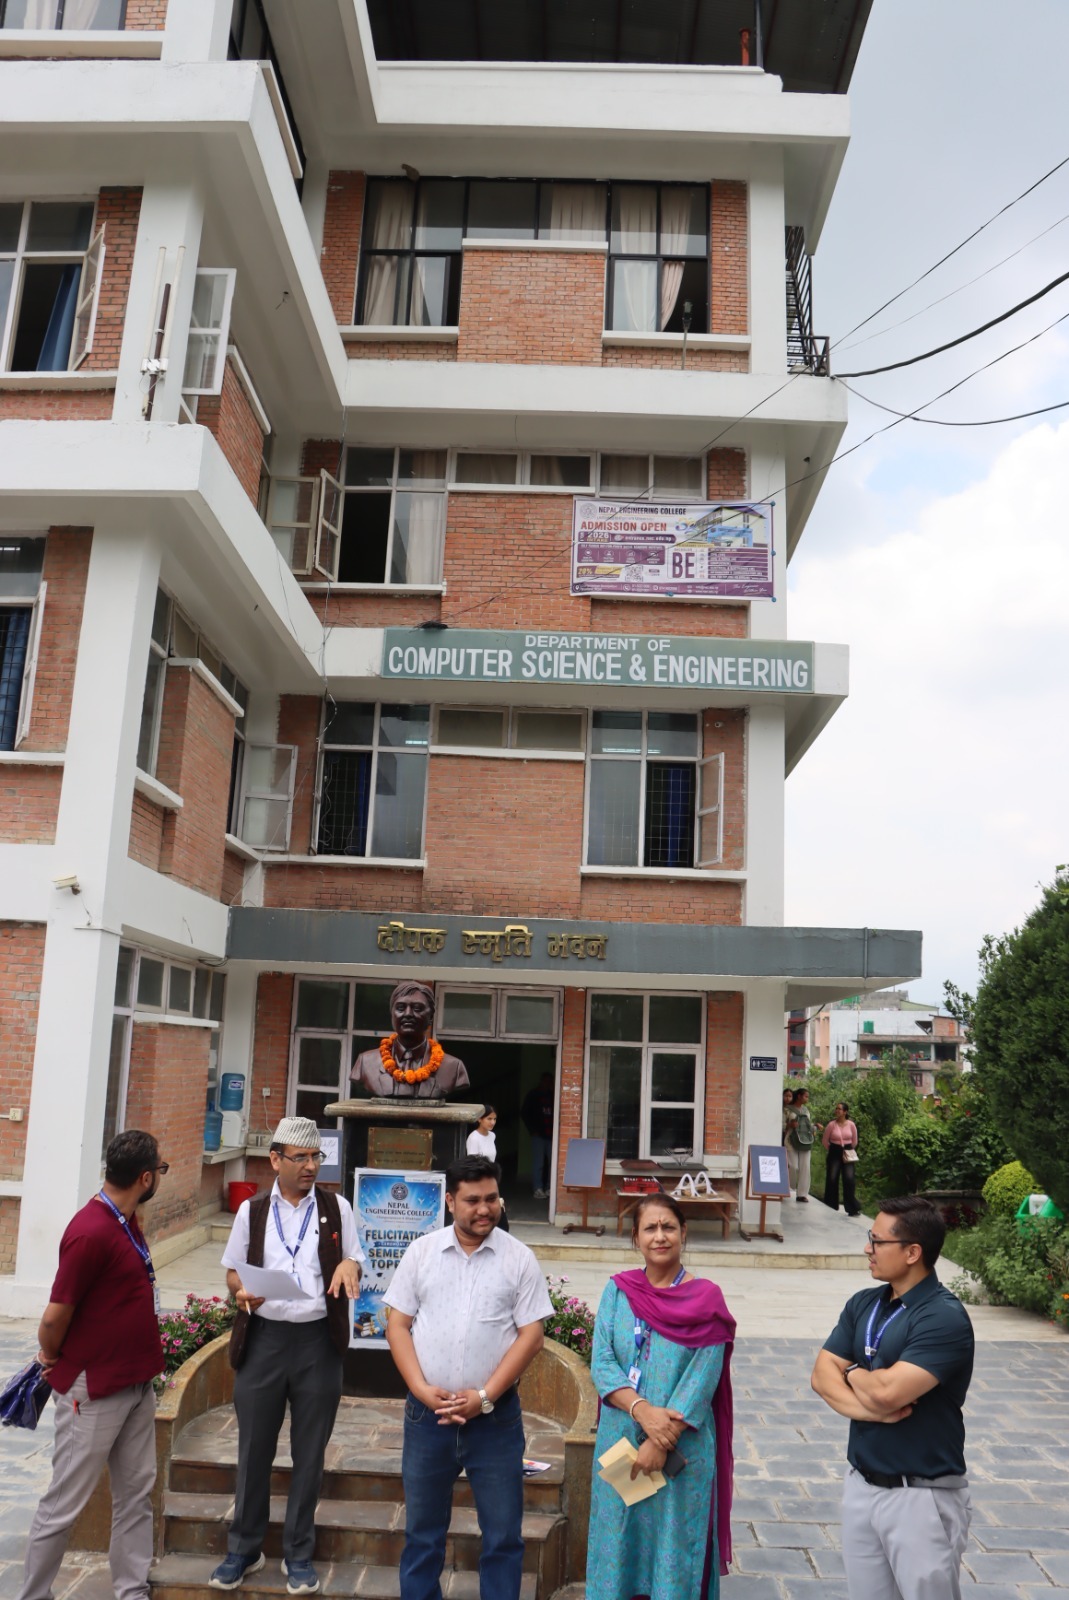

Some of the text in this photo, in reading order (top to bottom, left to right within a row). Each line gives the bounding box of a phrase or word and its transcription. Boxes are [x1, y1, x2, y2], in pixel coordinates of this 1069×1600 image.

[580, 521, 668, 532] ADMISSION OPEN
[672, 551, 695, 579] BE
[525, 635, 671, 652] DEPARTMENT OF
[388, 646, 808, 688] COMPUTER SCIENCE & ENGINEERING
[377, 921, 608, 963] दीपक स्मृति भवन
[365, 1207, 434, 1217] ENGINEERING COLLEGE
[387, 1201, 410, 1209] NEPAL
[365, 1229, 430, 1242] FELICITATIO
